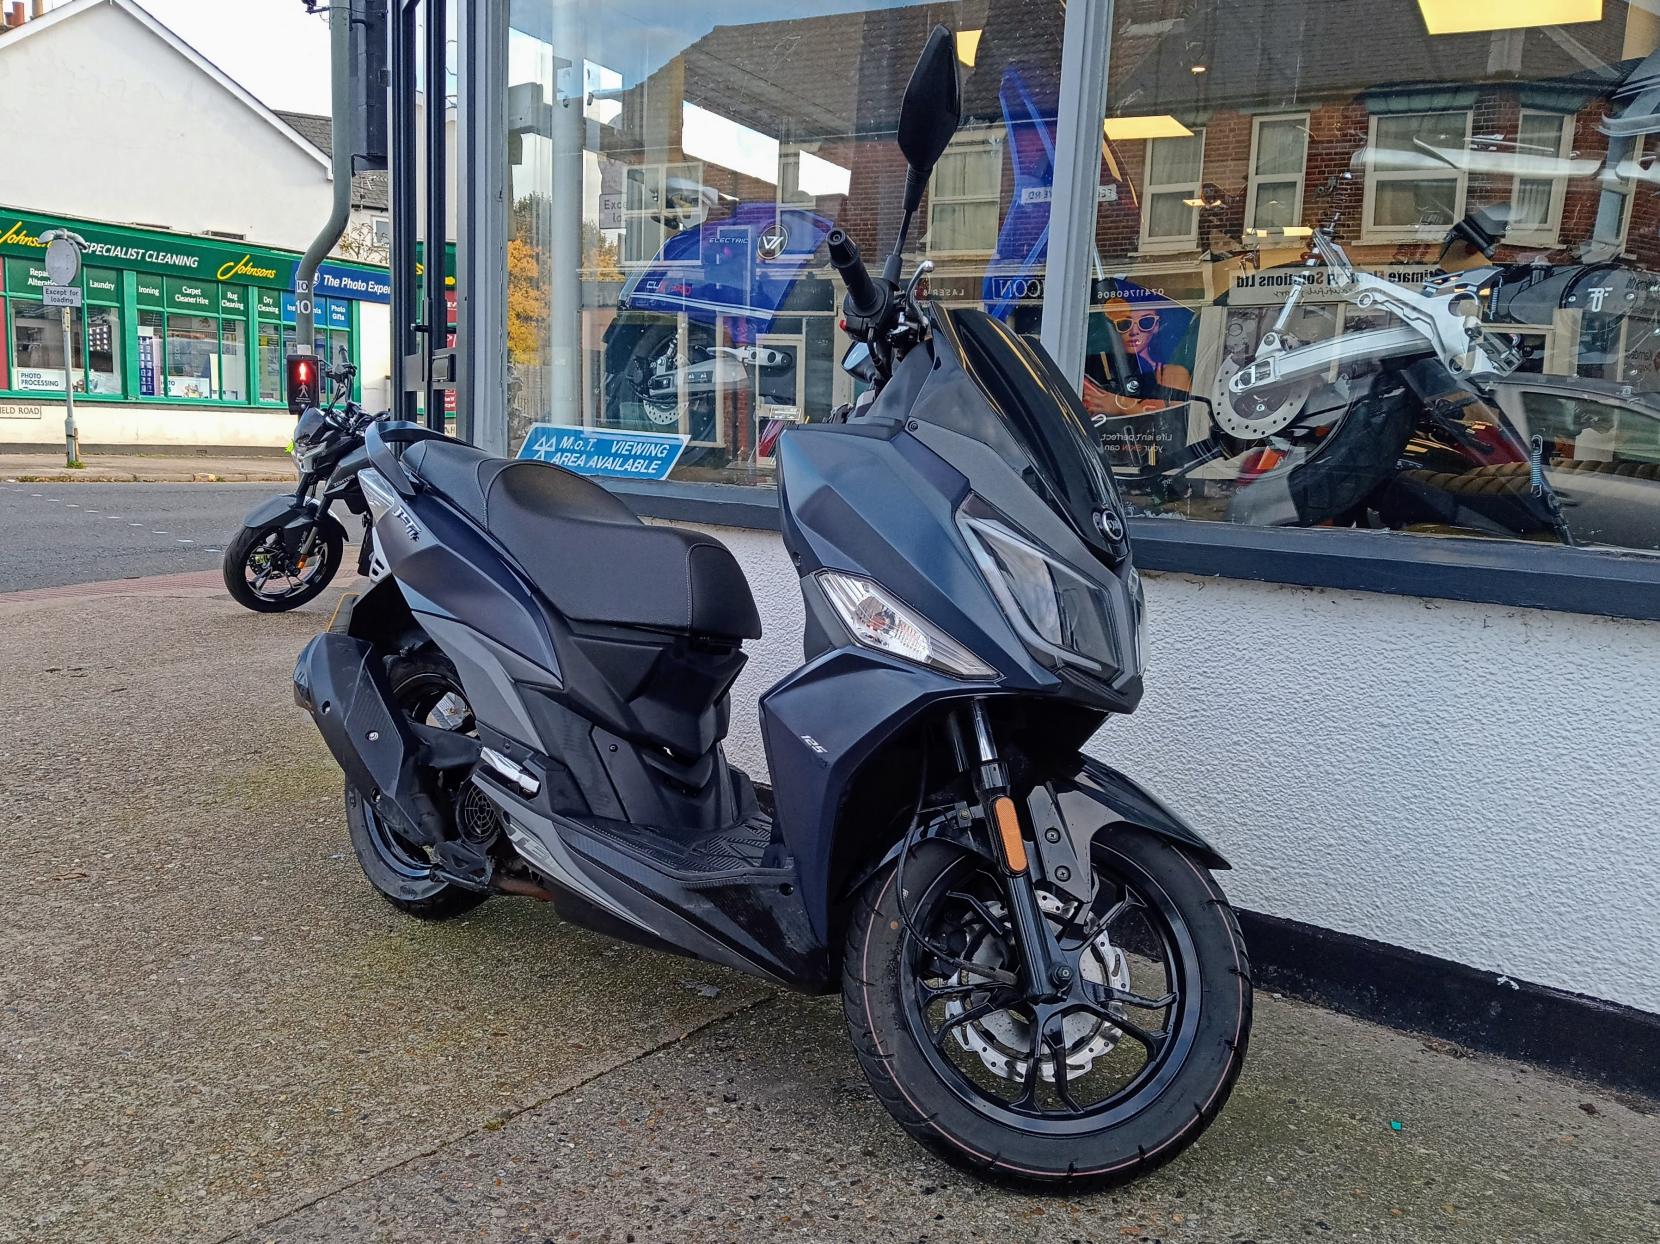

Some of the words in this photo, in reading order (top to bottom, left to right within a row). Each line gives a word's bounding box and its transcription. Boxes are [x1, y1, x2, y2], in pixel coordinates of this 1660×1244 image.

[82, 241, 145, 260] SPECIALIST
[145, 251, 199, 268] CLEANING
[217, 254, 277, 280] Johnsons
[89, 280, 115, 291] Laundry
[323, 274, 341, 288] The
[341, 277, 368, 292] Photo
[45, 288, 67, 296] Except
[138, 286, 160, 297] Ironing
[182, 286, 202, 296] Carpet
[50, 296, 74, 304] loading
[174, 294, 197, 304] Cleaner
[227, 292, 238, 301] Rug
[263, 296, 274, 305] Dry
[221, 300, 244, 310] Cleaning
[257, 303, 280, 314] Cleaning
[295, 299, 312, 314] 10
[331, 304, 346, 313] Photo
[332, 312, 345, 321] Gifts
[18, 407, 41, 415] ROAD
[611, 440, 670, 458] VIEWING
[549, 452, 586, 468] AREA
[587, 455, 662, 474] AVAILABLE
[800, 735, 829, 753] 125
